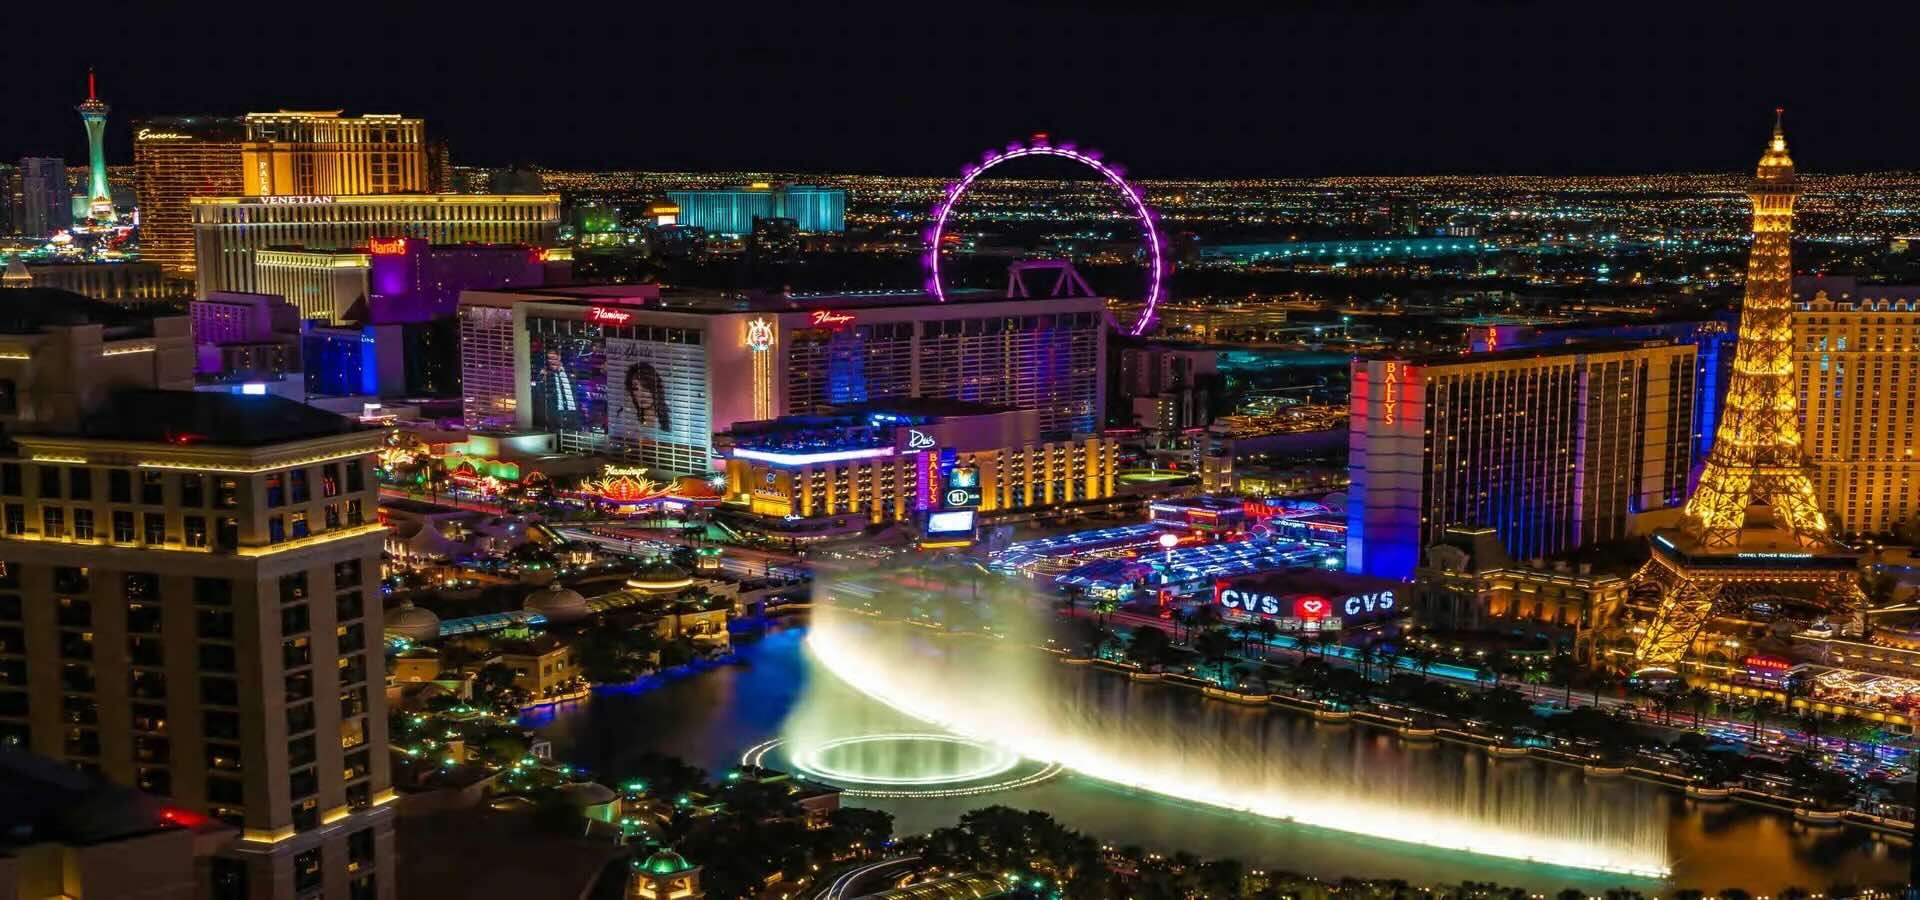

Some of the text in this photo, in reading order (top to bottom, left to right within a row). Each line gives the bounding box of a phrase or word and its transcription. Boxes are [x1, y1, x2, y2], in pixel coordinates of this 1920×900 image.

[138, 128, 192, 141] Encore
[260, 195, 333, 204] VENETIAN
[592, 306, 631, 323] Flamingo
[812, 311, 855, 325] Flamingo
[604, 464, 648, 479] Flamingo
[1221, 589, 1278, 614] CVS
[1345, 591, 1393, 615] CVS
